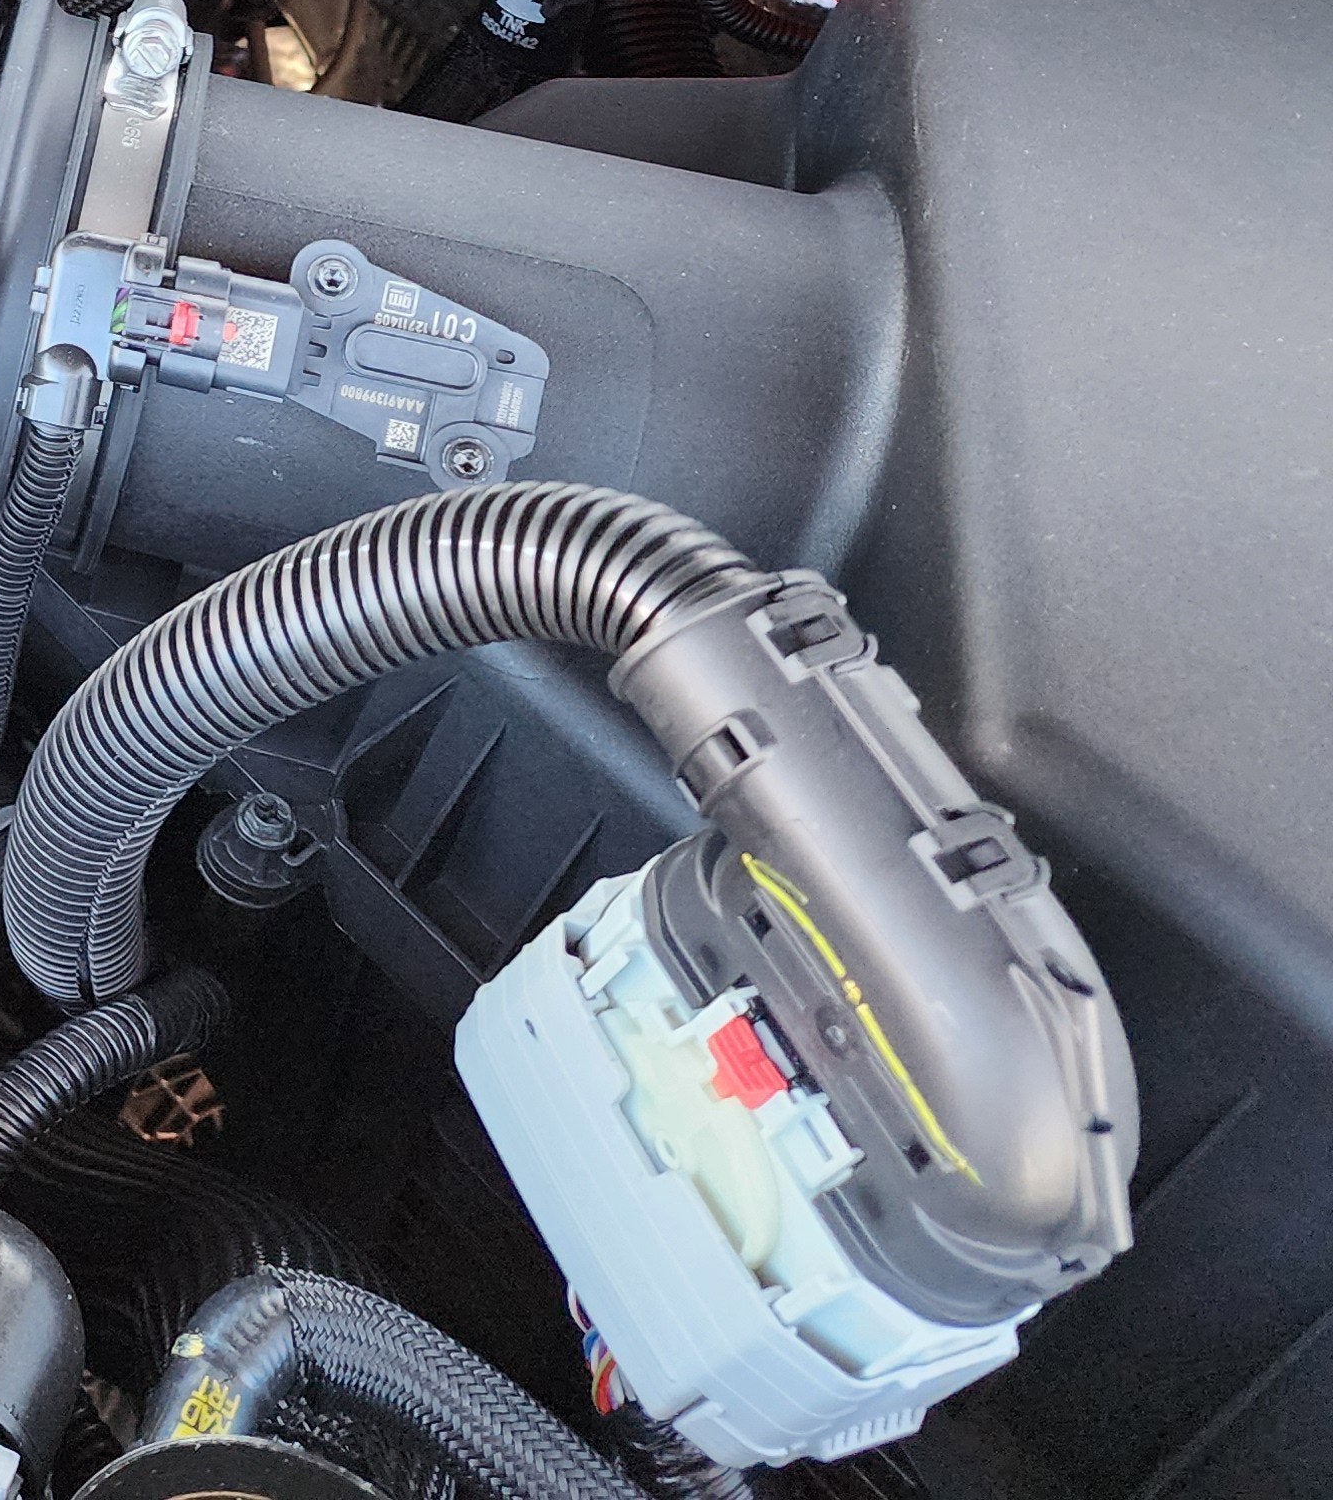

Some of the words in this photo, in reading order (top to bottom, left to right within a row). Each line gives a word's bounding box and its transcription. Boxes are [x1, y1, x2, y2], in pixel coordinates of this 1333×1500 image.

[500, 10, 530, 35] TNK
[385, 285, 416, 313] gm
[431, 311, 477, 343] C01
